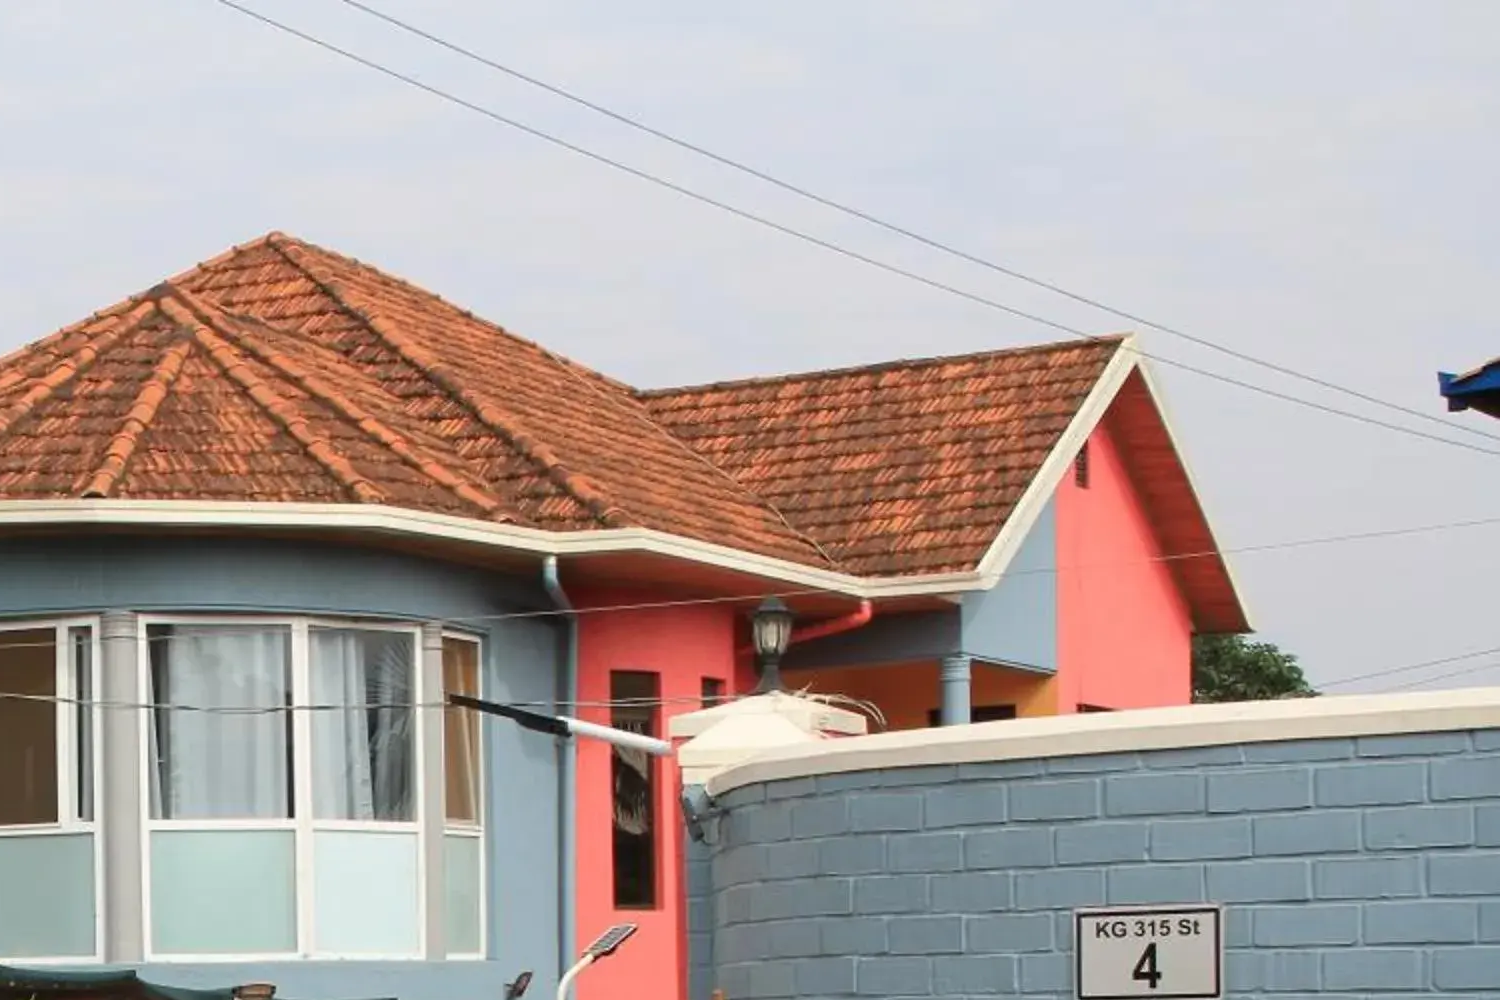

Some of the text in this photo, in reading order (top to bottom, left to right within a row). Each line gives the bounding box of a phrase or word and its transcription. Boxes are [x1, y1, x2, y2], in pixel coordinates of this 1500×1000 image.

[1095, 918, 1201, 939] KG 315 St
[1132, 941, 1163, 989] 4
